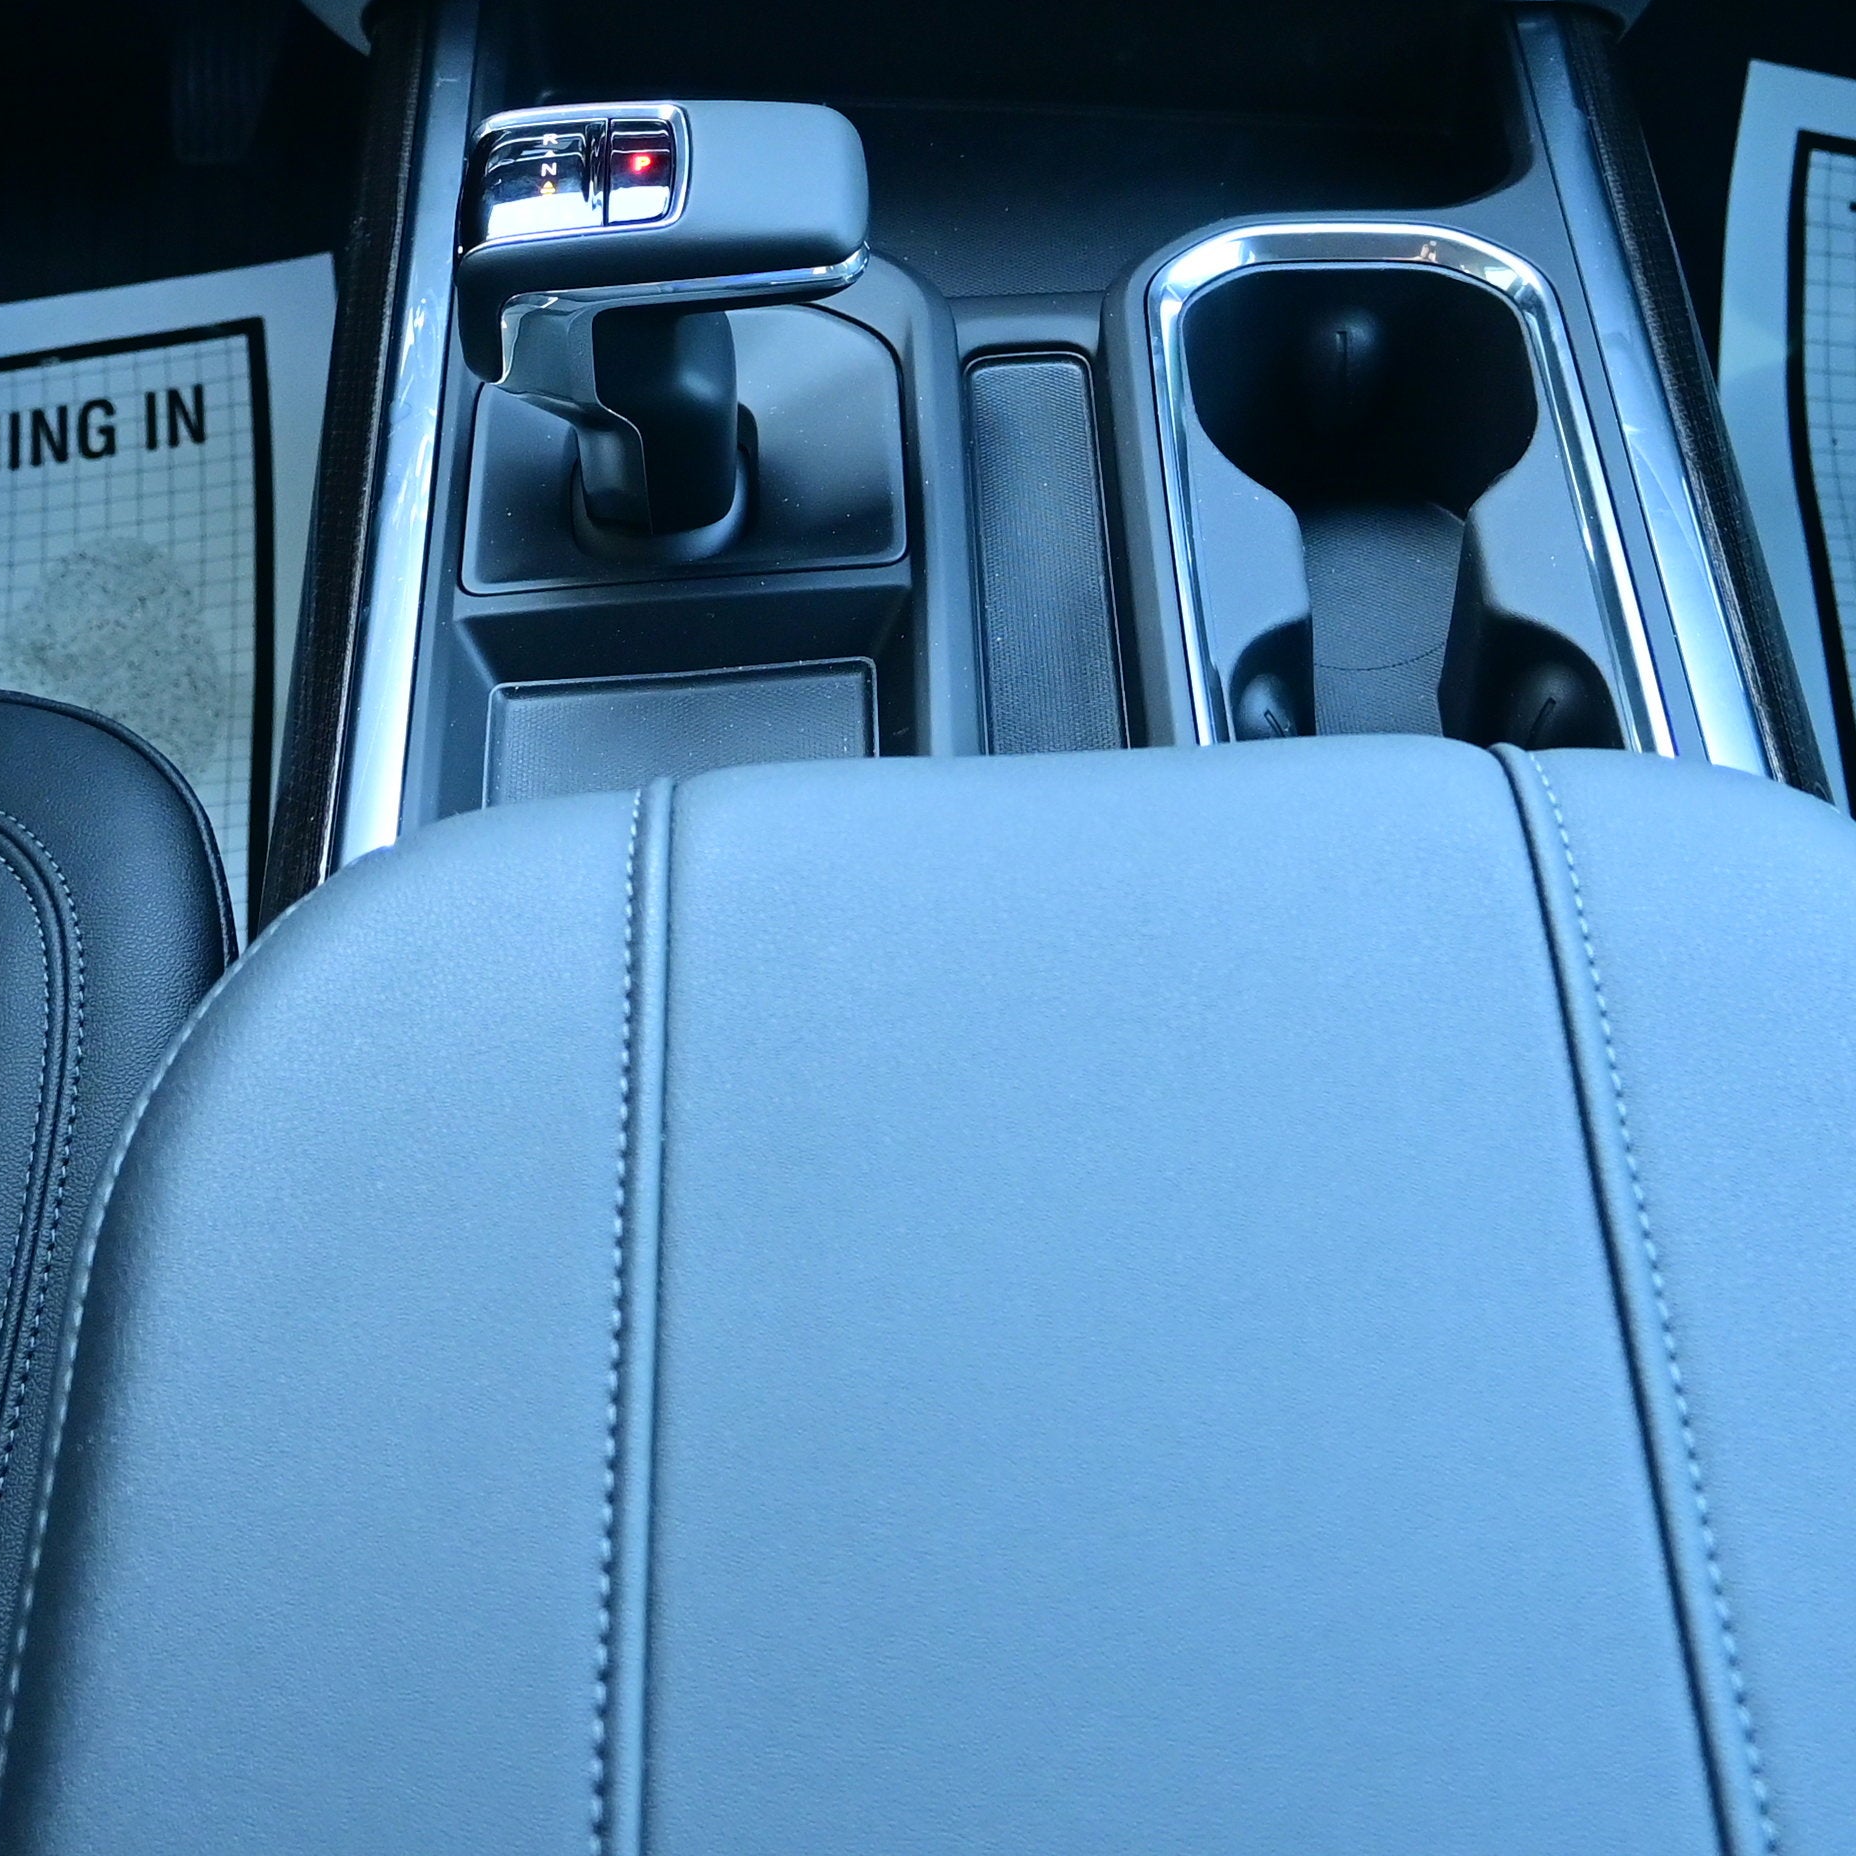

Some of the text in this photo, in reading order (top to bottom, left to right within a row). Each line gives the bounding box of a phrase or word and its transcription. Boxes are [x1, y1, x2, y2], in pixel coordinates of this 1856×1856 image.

[541, 162, 557, 177] N
[634, 155, 651, 172] P
[144, 383, 207, 452] IN
